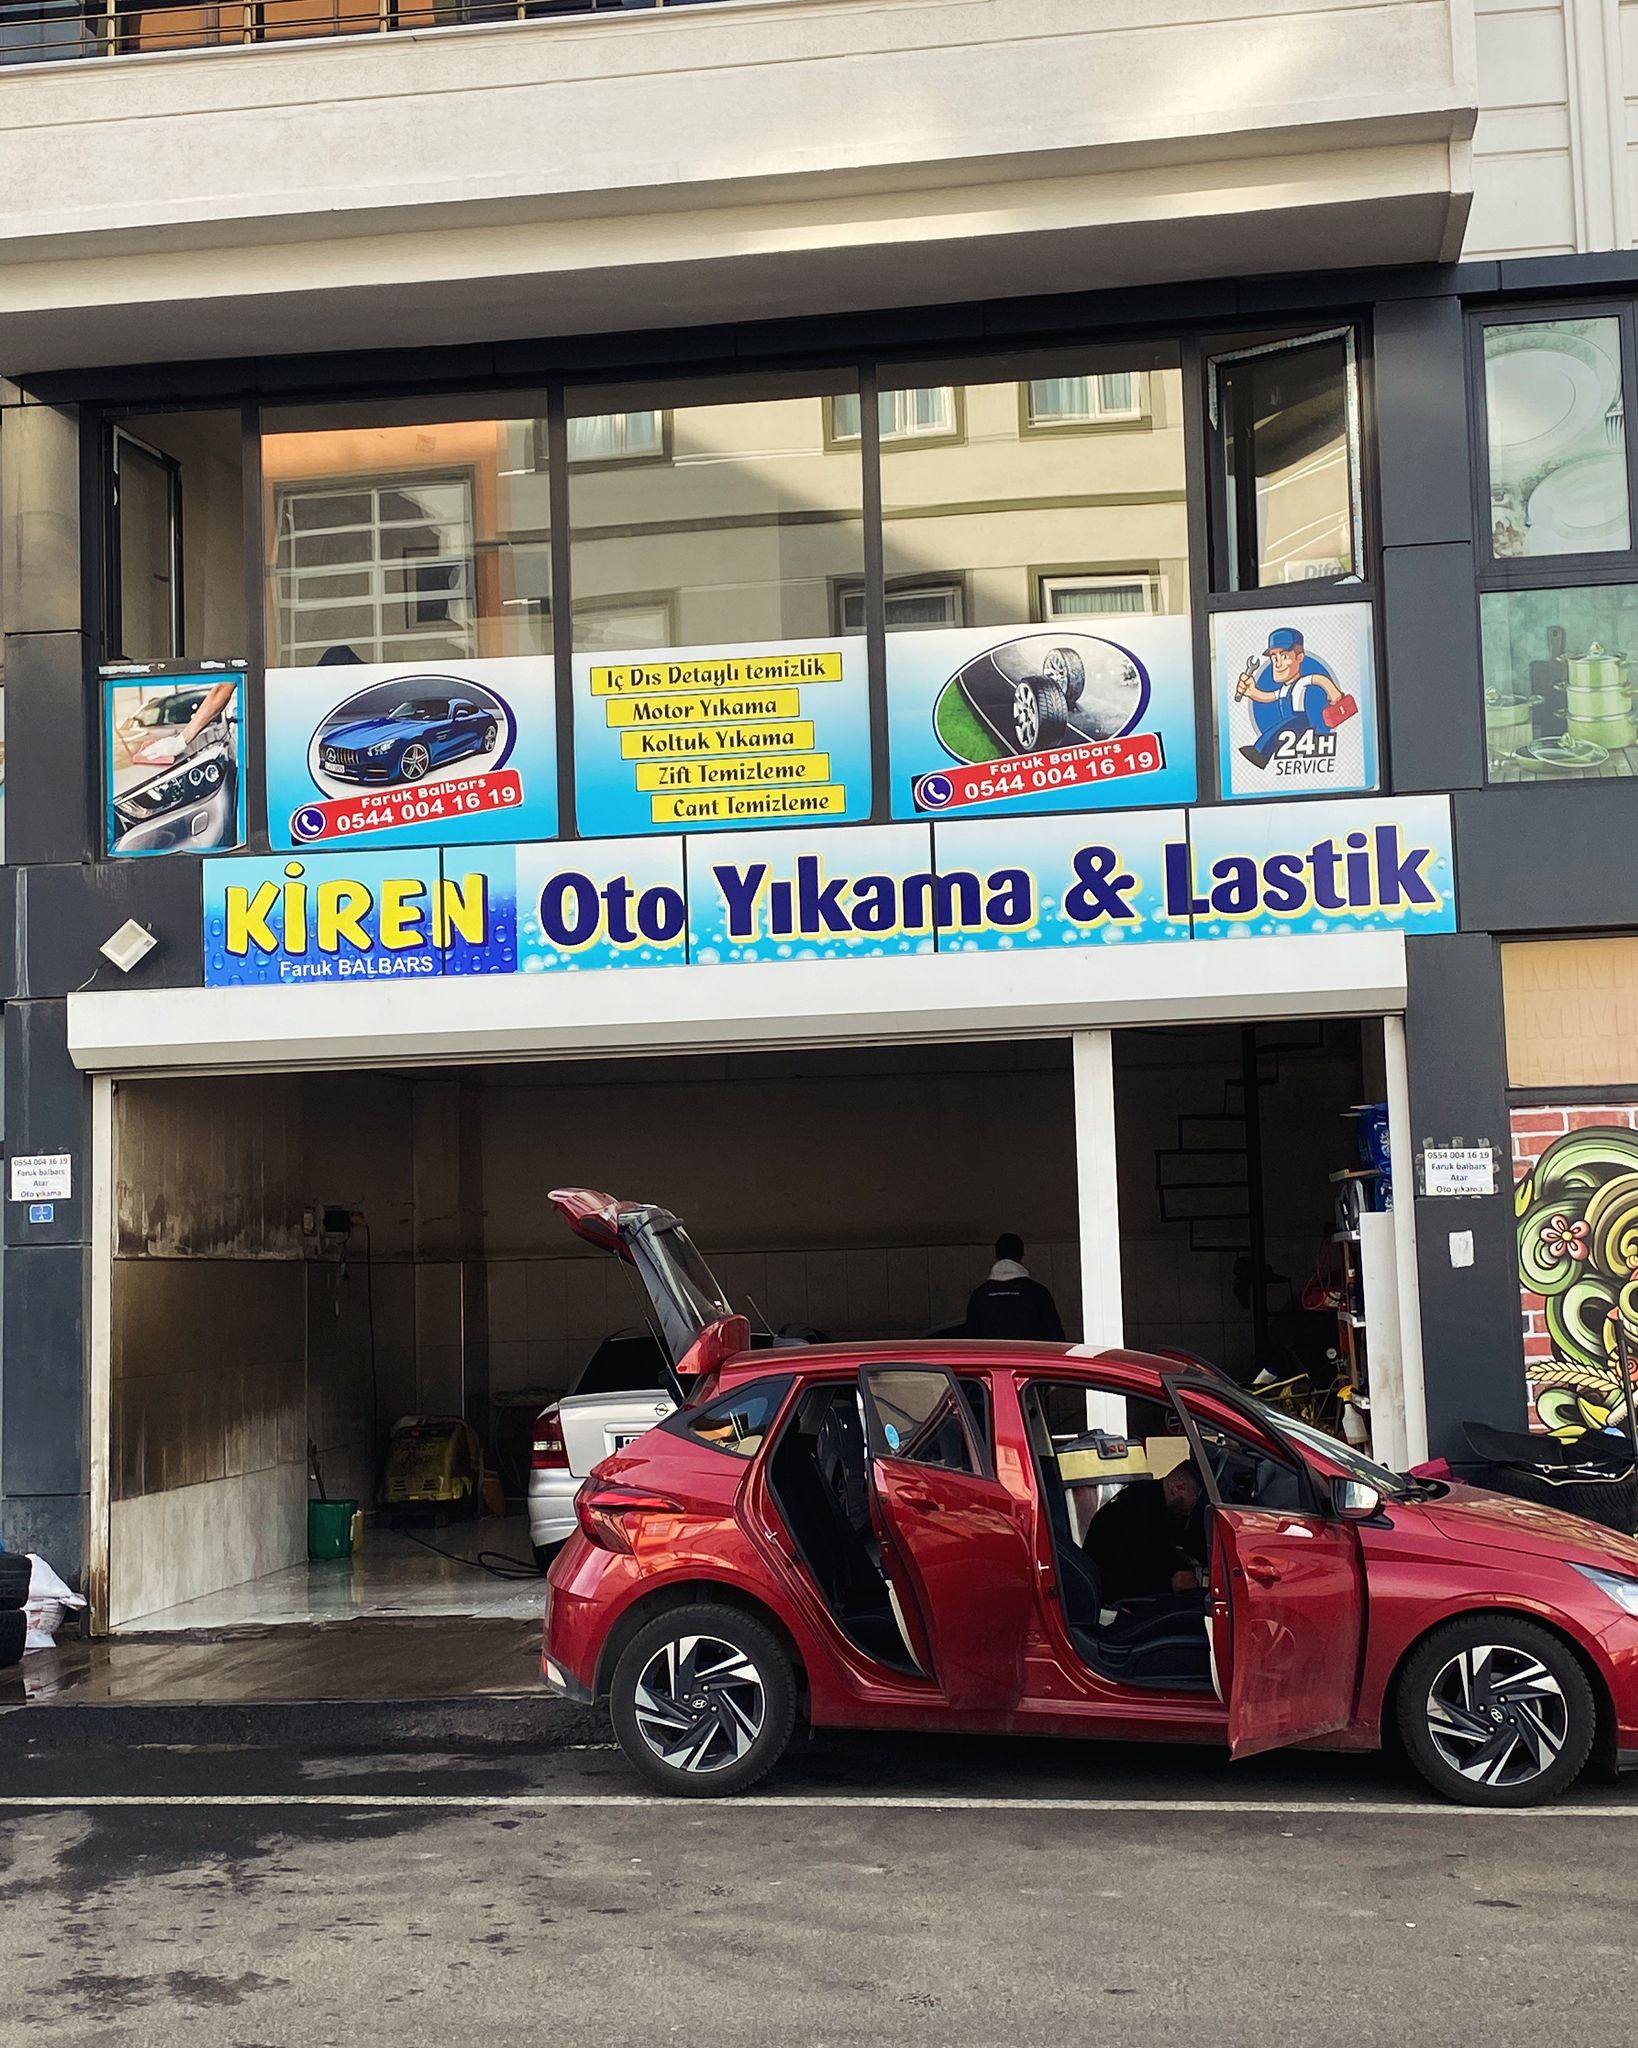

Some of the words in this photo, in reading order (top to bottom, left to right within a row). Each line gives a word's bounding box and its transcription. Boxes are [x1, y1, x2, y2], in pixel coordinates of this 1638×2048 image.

[668, 663, 738, 686] Detaylı
[745, 659, 826, 679] temizlik
[633, 702, 694, 720] Motor
[700, 698, 777, 717] Yıkama
[642, 732, 710, 752] Koltuk
[715, 728, 794, 748] Yıkama
[990, 755, 1045, 776] Faruk
[1049, 742, 1123, 764] Balbars
[1276, 758, 1335, 776] SERVICE
[658, 766, 692, 785] Zift
[698, 762, 806, 782] Temizleme
[964, 775, 1025, 800] 0544
[1032, 766, 1078, 787] 004
[1085, 758, 1115, 777] 16
[1124, 750, 1155, 771] 19
[361, 789, 414, 809] Faruk
[417, 777, 487, 797] Balbars
[673, 798, 719, 817] Cant
[726, 793, 829, 813] Temizleme
[336, 809, 395, 832] 0544
[401, 799, 445, 819] 004
[452, 792, 481, 811] 16
[488, 785, 517, 804] 19
[540, 871, 685, 947] Oto
[712, 855, 1033, 936] Yıkama
[1064, 846, 1135, 922] &
[1165, 825, 1436, 917] Lastik
[225, 861, 488, 958] KİREN
[280, 962, 332, 977] Faruk
[338, 956, 434, 976] BALBARS
[1431, 1163, 1454, 1171] Faruk
